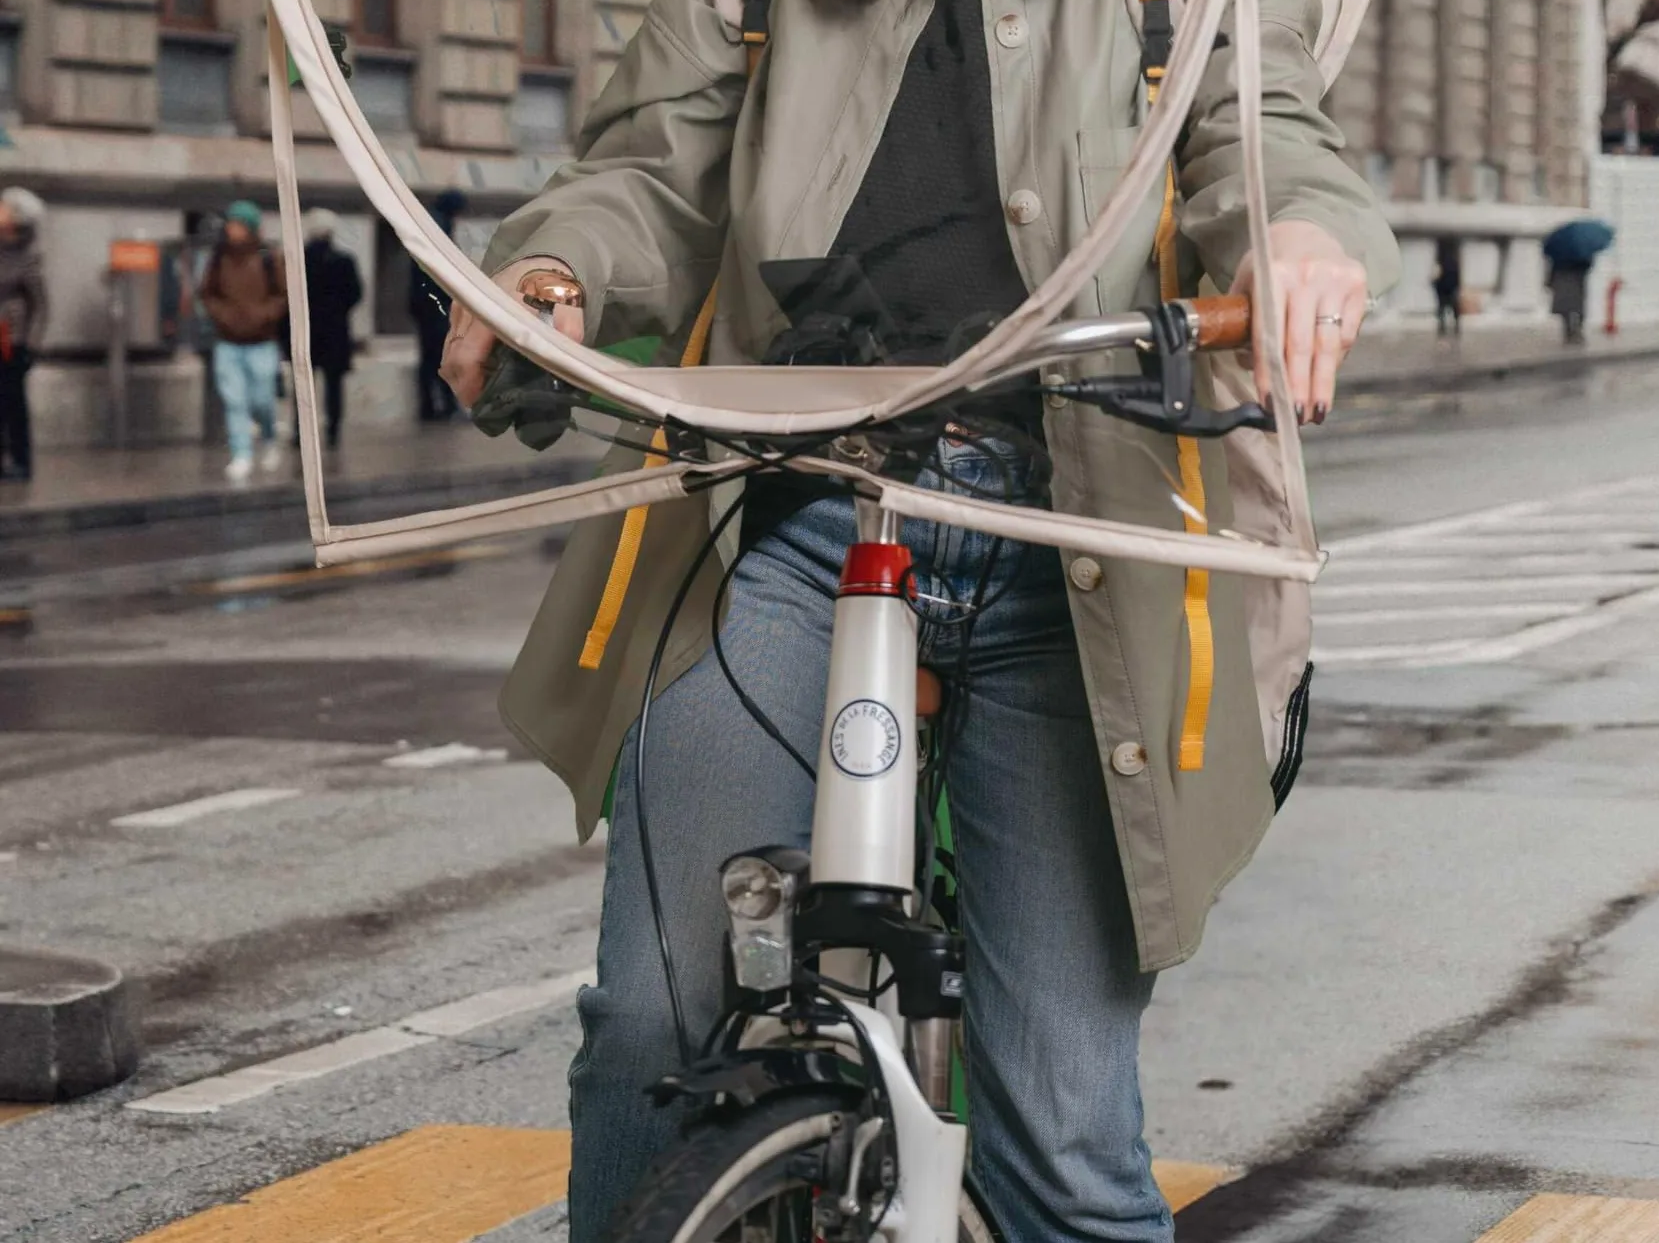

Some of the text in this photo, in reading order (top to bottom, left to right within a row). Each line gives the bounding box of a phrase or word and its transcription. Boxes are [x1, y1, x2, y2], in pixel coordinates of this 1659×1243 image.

[834, 732, 849, 763] INES
[847, 708, 860, 719] LA
[862, 704, 897, 766] FRESSANGE
